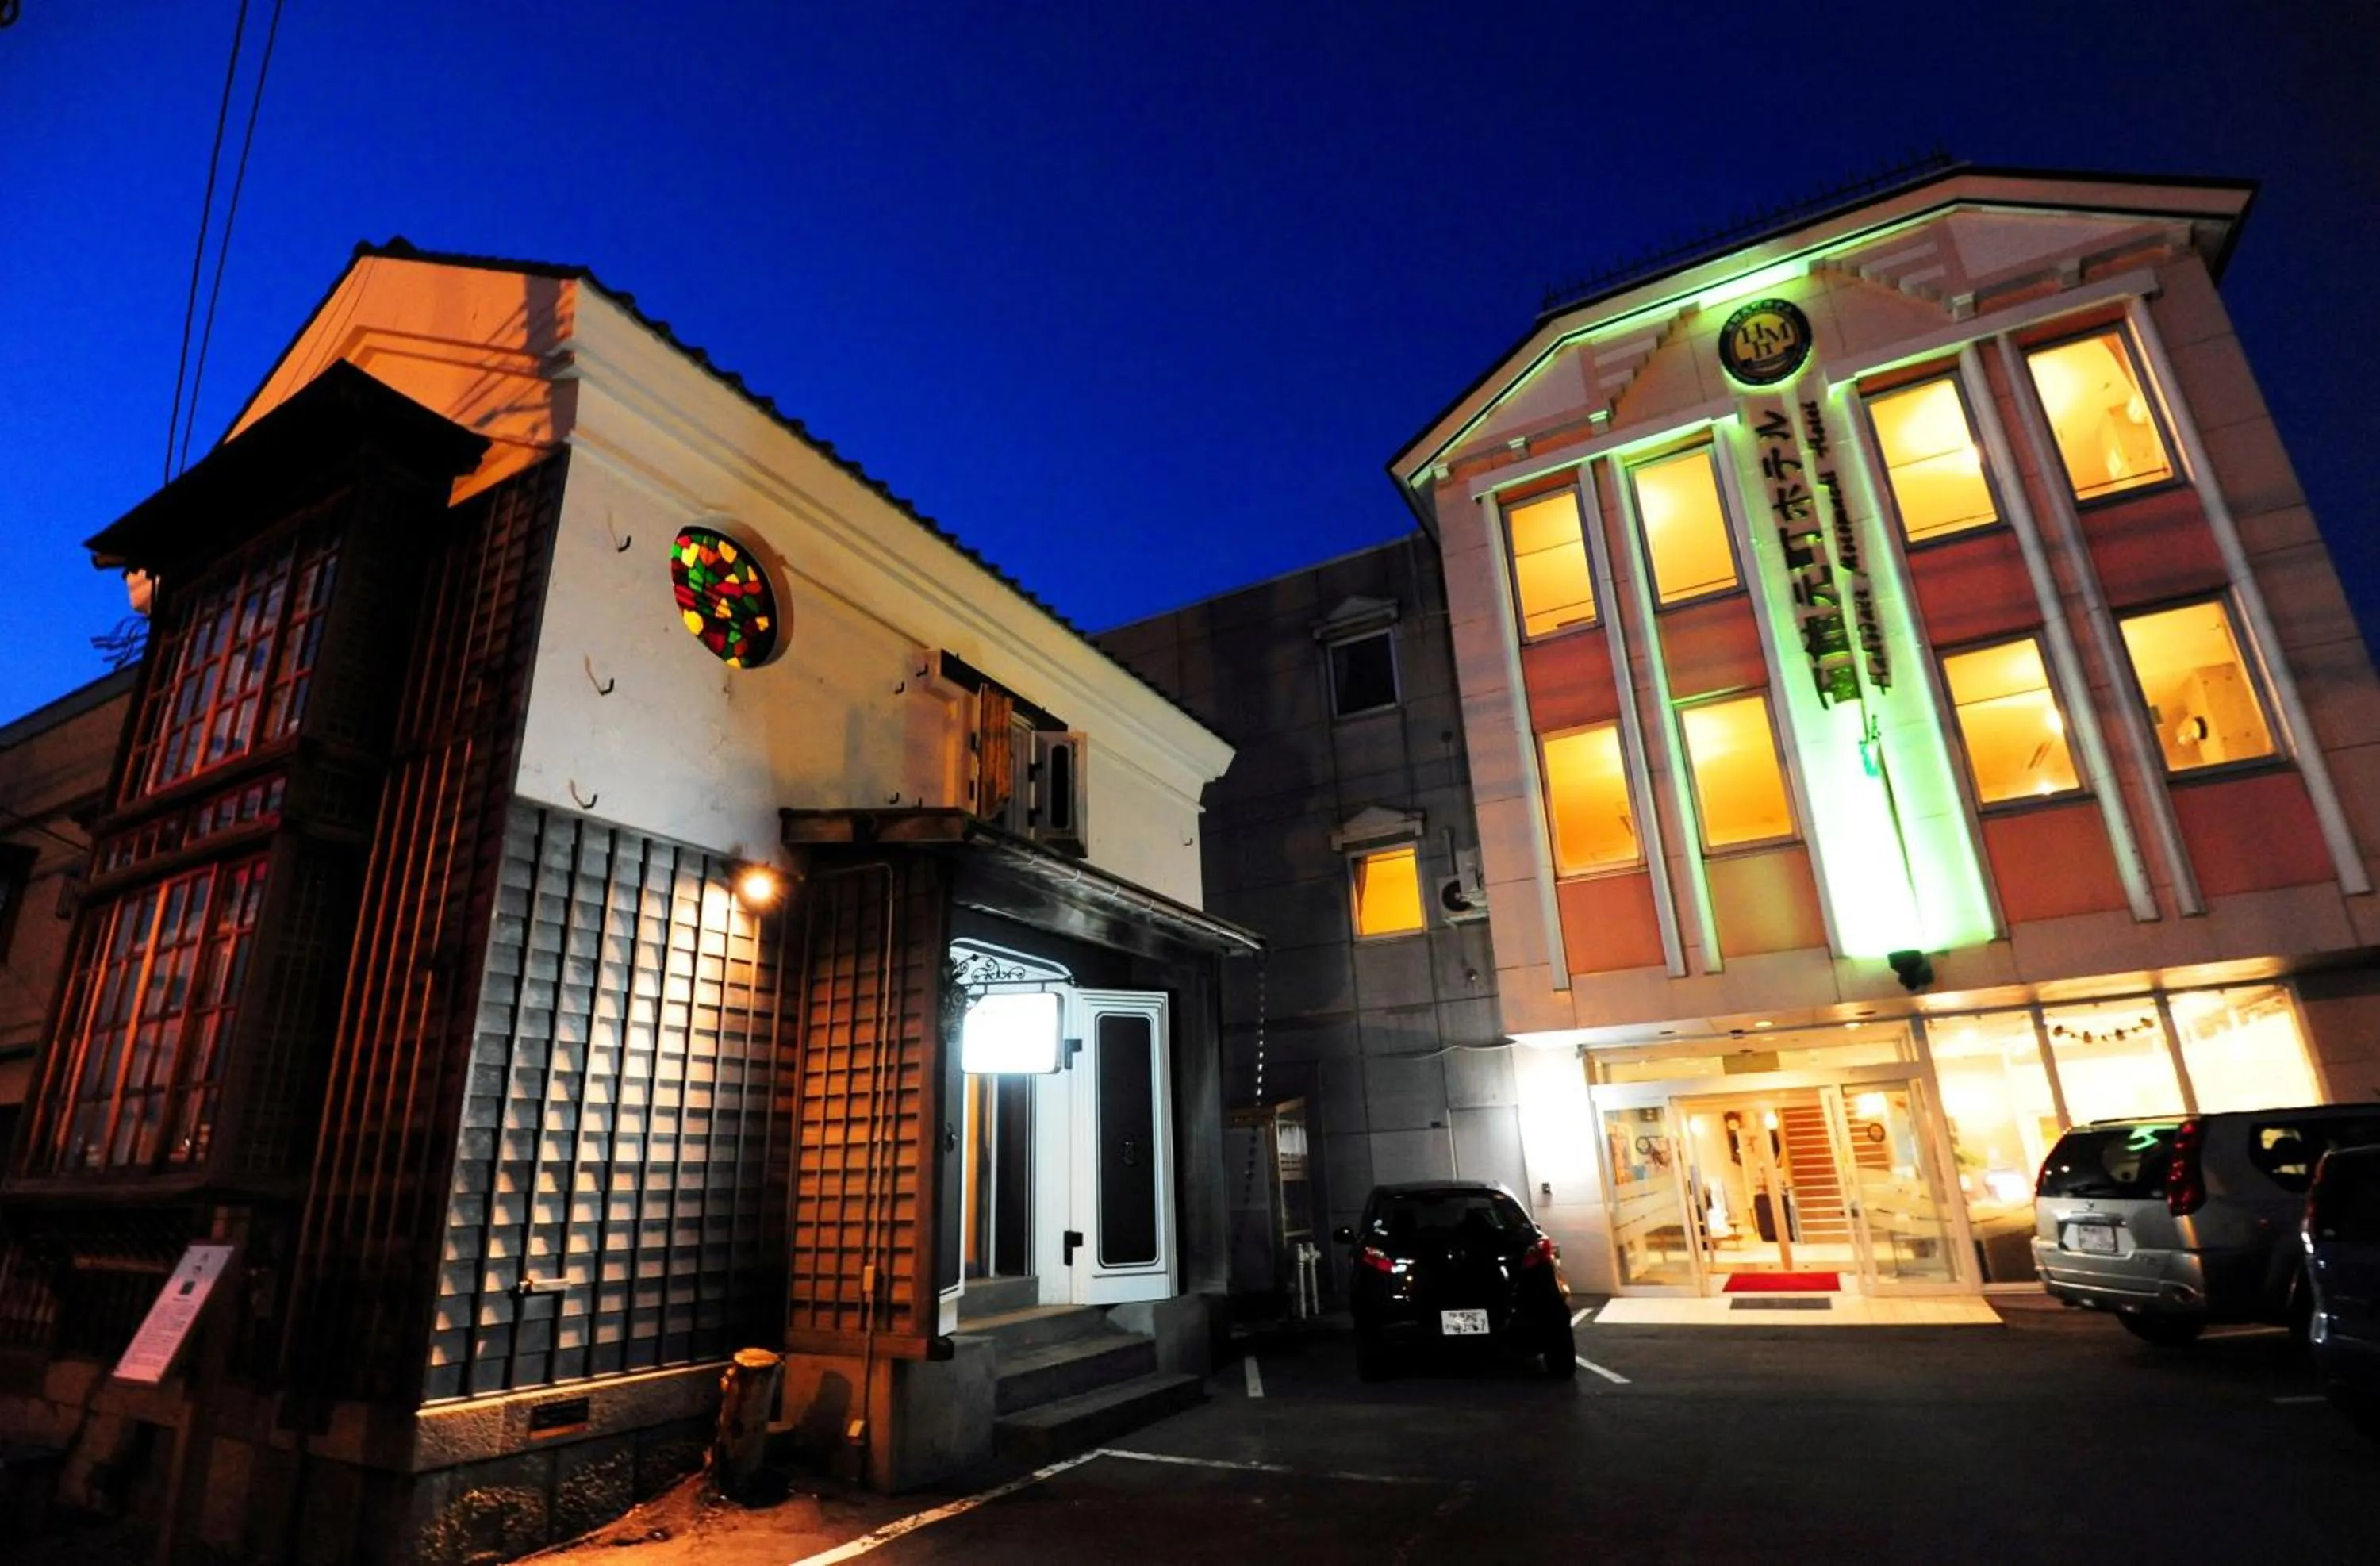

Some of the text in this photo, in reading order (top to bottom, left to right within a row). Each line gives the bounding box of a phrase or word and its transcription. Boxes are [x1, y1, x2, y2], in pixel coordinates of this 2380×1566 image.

[1756, 410, 1861, 711] 函館元町ホテル
